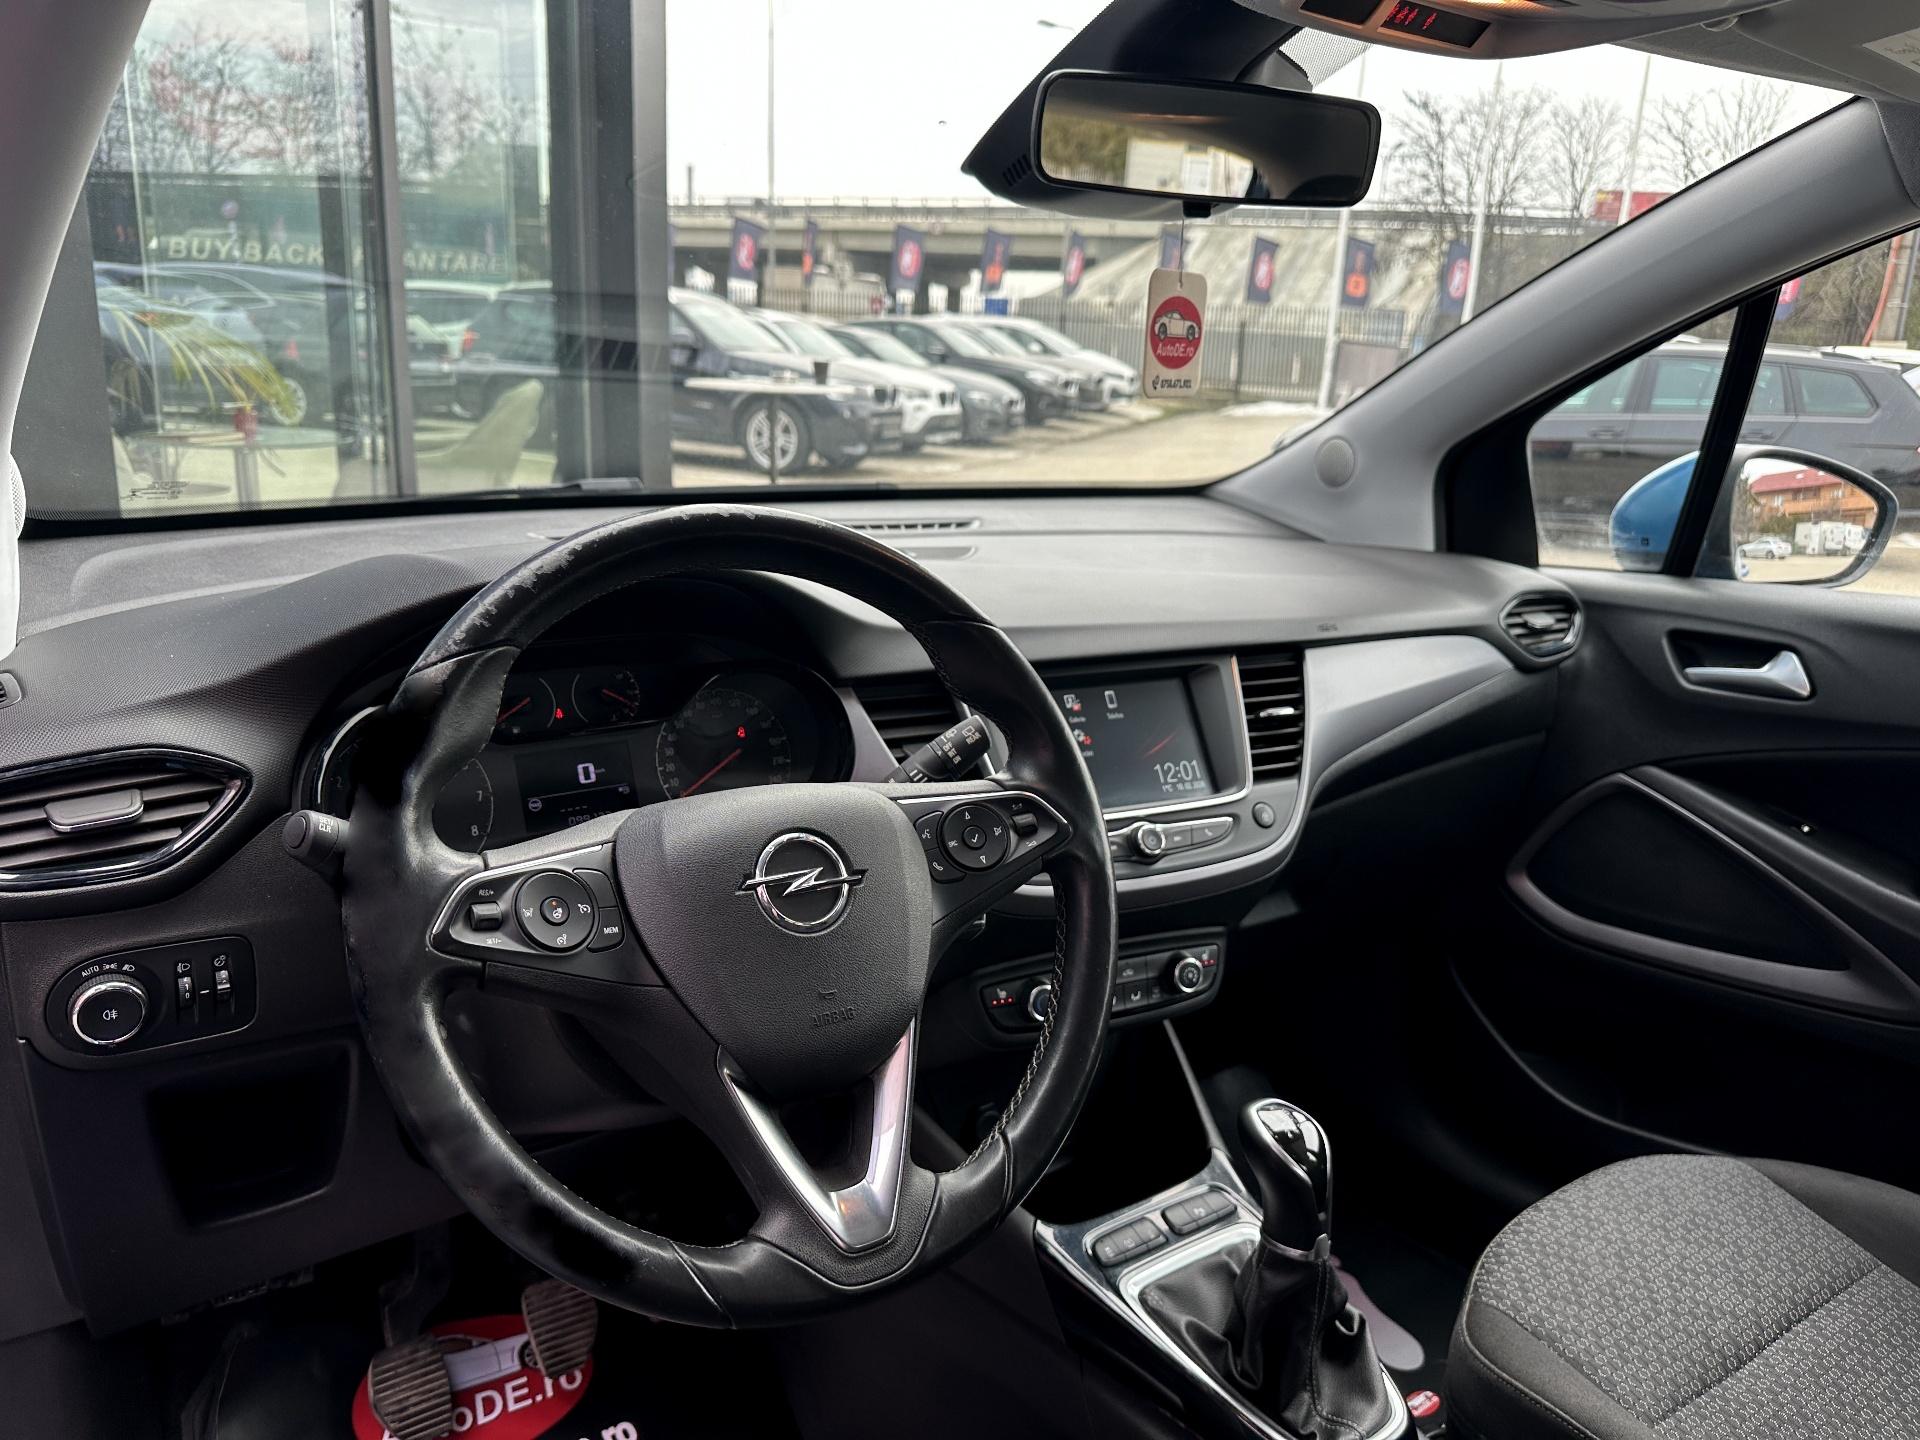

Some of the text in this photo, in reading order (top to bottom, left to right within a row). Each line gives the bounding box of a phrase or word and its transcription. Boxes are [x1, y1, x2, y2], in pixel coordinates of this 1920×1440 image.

[243, 239, 324, 266] BACK
[576, 762, 597, 785] 0
[1153, 759, 1201, 784] 12:01
[475, 790, 483, 803] 7
[470, 824, 479, 837] 8
[603, 926, 619, 935] MEM
[81, 964, 100, 978] AUTO
